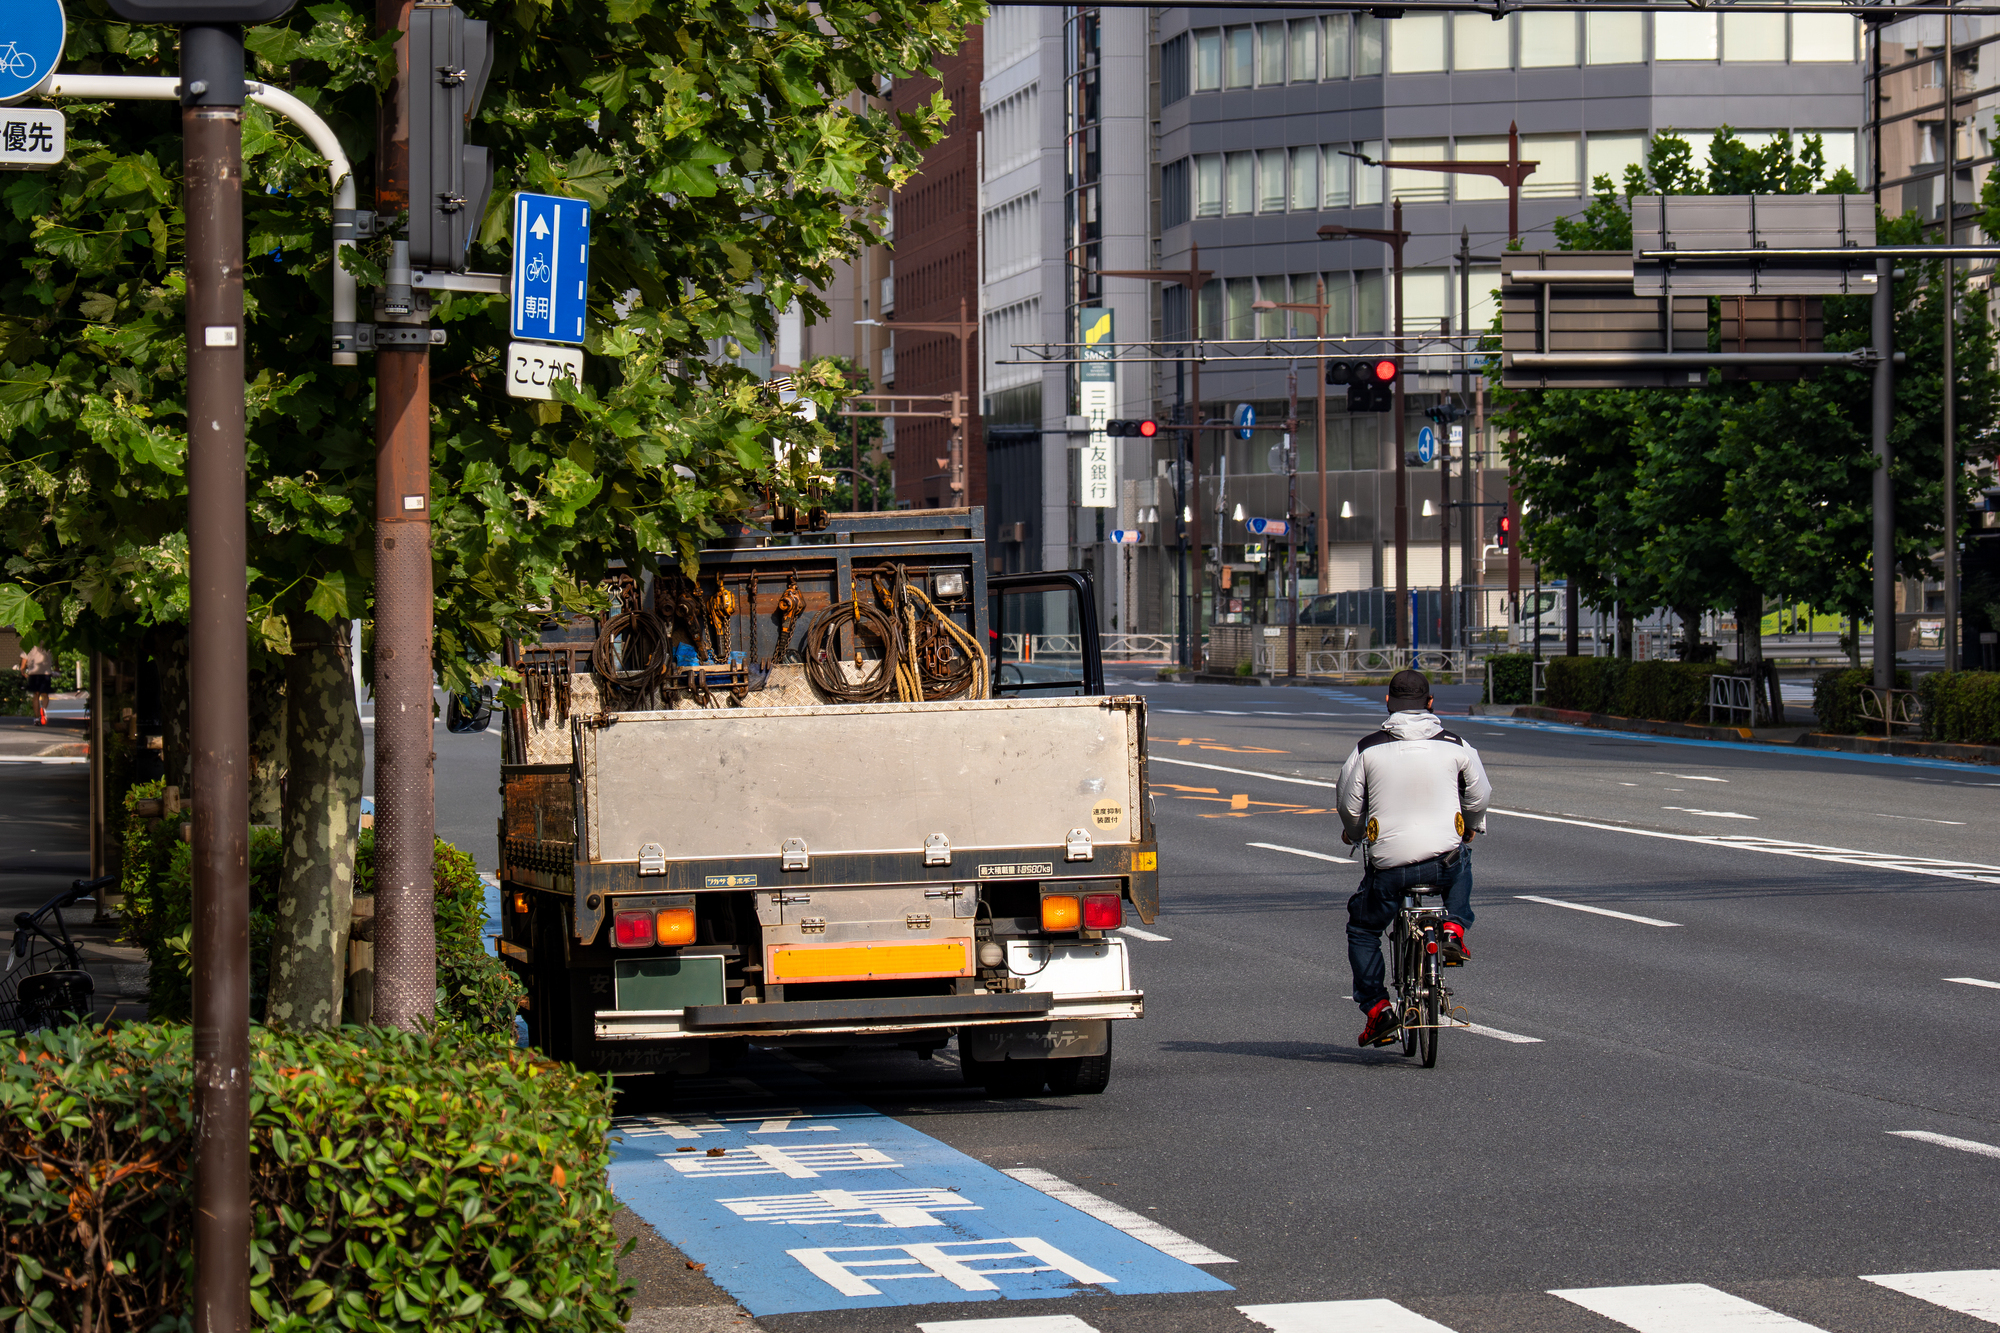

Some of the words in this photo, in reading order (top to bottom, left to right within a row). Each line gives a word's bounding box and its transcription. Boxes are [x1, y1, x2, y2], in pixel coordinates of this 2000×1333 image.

[0, 120, 53, 152] 優先
[525, 296, 549, 320] 専用
[515, 357, 577, 388] ここから
[1090, 389, 1107, 499] 三井住友銀行
[981, 866, 1015, 875] 最大積載量
